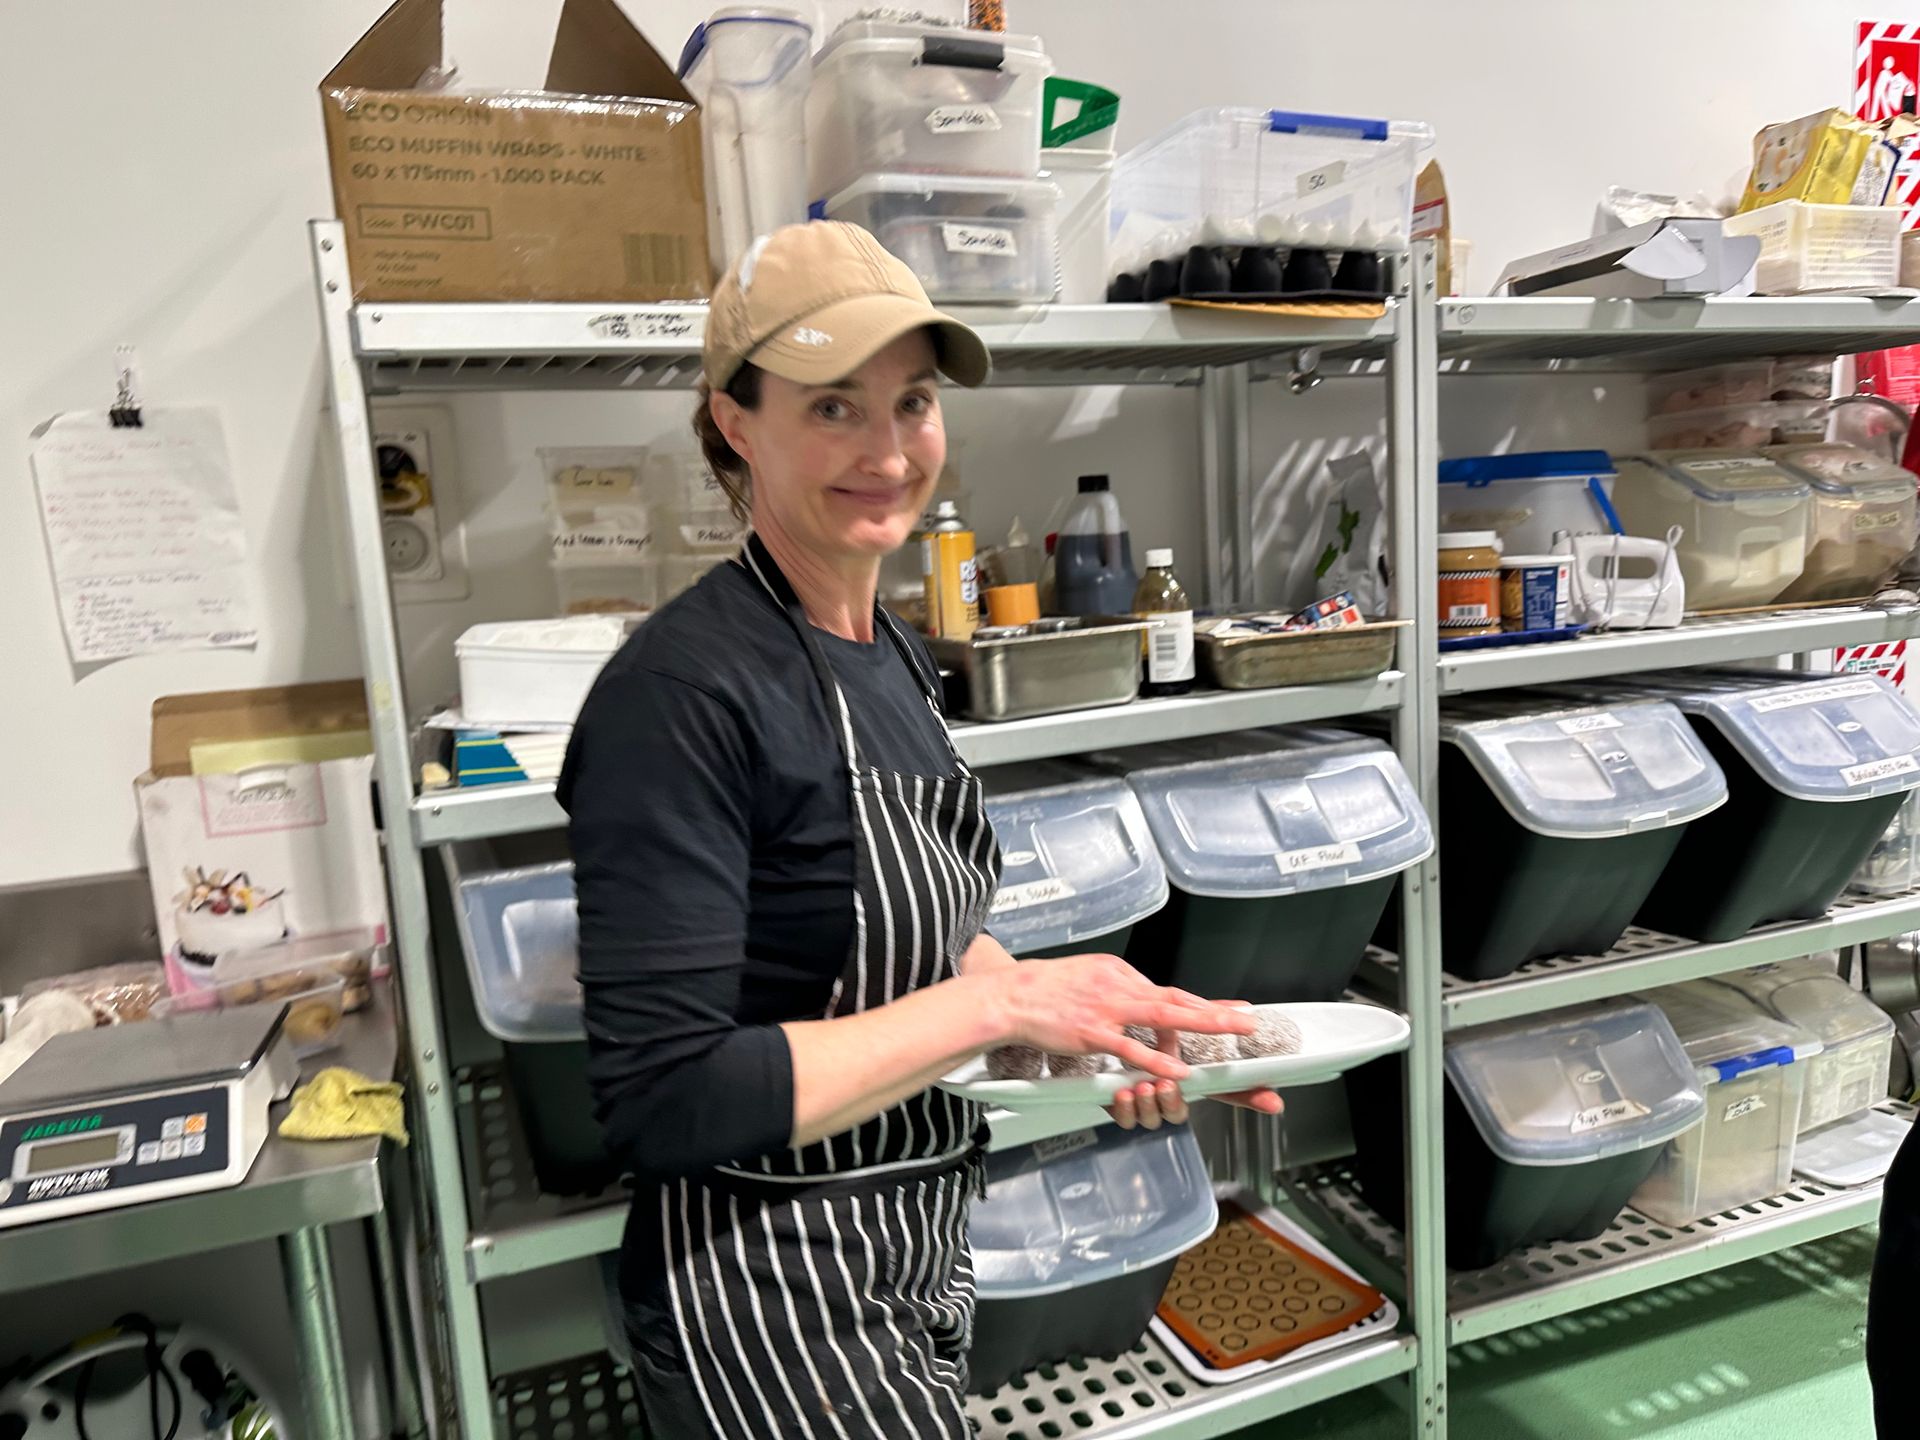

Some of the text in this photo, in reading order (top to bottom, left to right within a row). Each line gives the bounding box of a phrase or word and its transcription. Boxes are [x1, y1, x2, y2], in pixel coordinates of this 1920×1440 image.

[346, 102, 491, 125] ECO ORIGIN
[350, 136, 394, 152] ECO
[400, 138, 482, 155] MUFFIN
[488, 141, 564, 158] WRAPS
[582, 144, 647, 161] WHITE
[352, 163, 379, 180] 60
[401, 164, 475, 182] 175mm
[549, 169, 606, 185] PACK
[403, 212, 474, 231] PWC01
[20, 1114, 105, 1142] JADEVER
